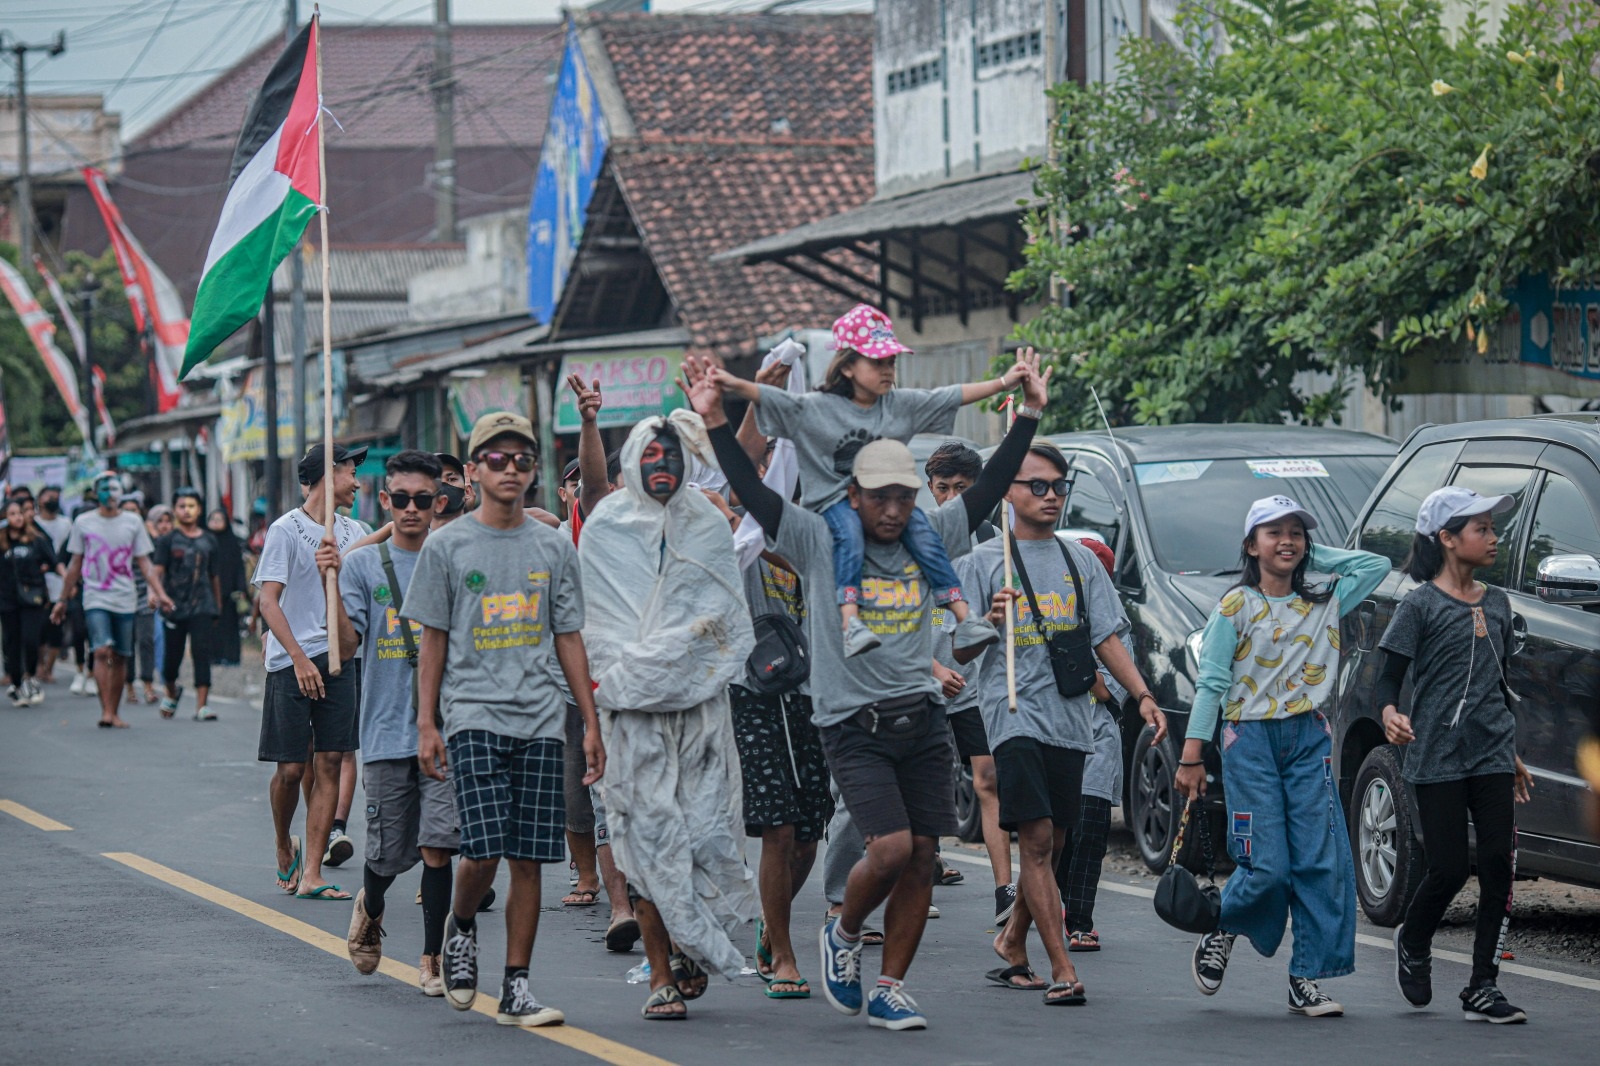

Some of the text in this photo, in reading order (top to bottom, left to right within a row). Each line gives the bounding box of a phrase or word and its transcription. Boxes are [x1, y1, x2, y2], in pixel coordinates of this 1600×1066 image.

[1259, 466, 1280, 474] ALL
[481, 590, 541, 626] PSM
[1016, 590, 1078, 622] PSM
[1014, 622, 1038, 635] ecint
[377, 636, 406, 648] Pecint
